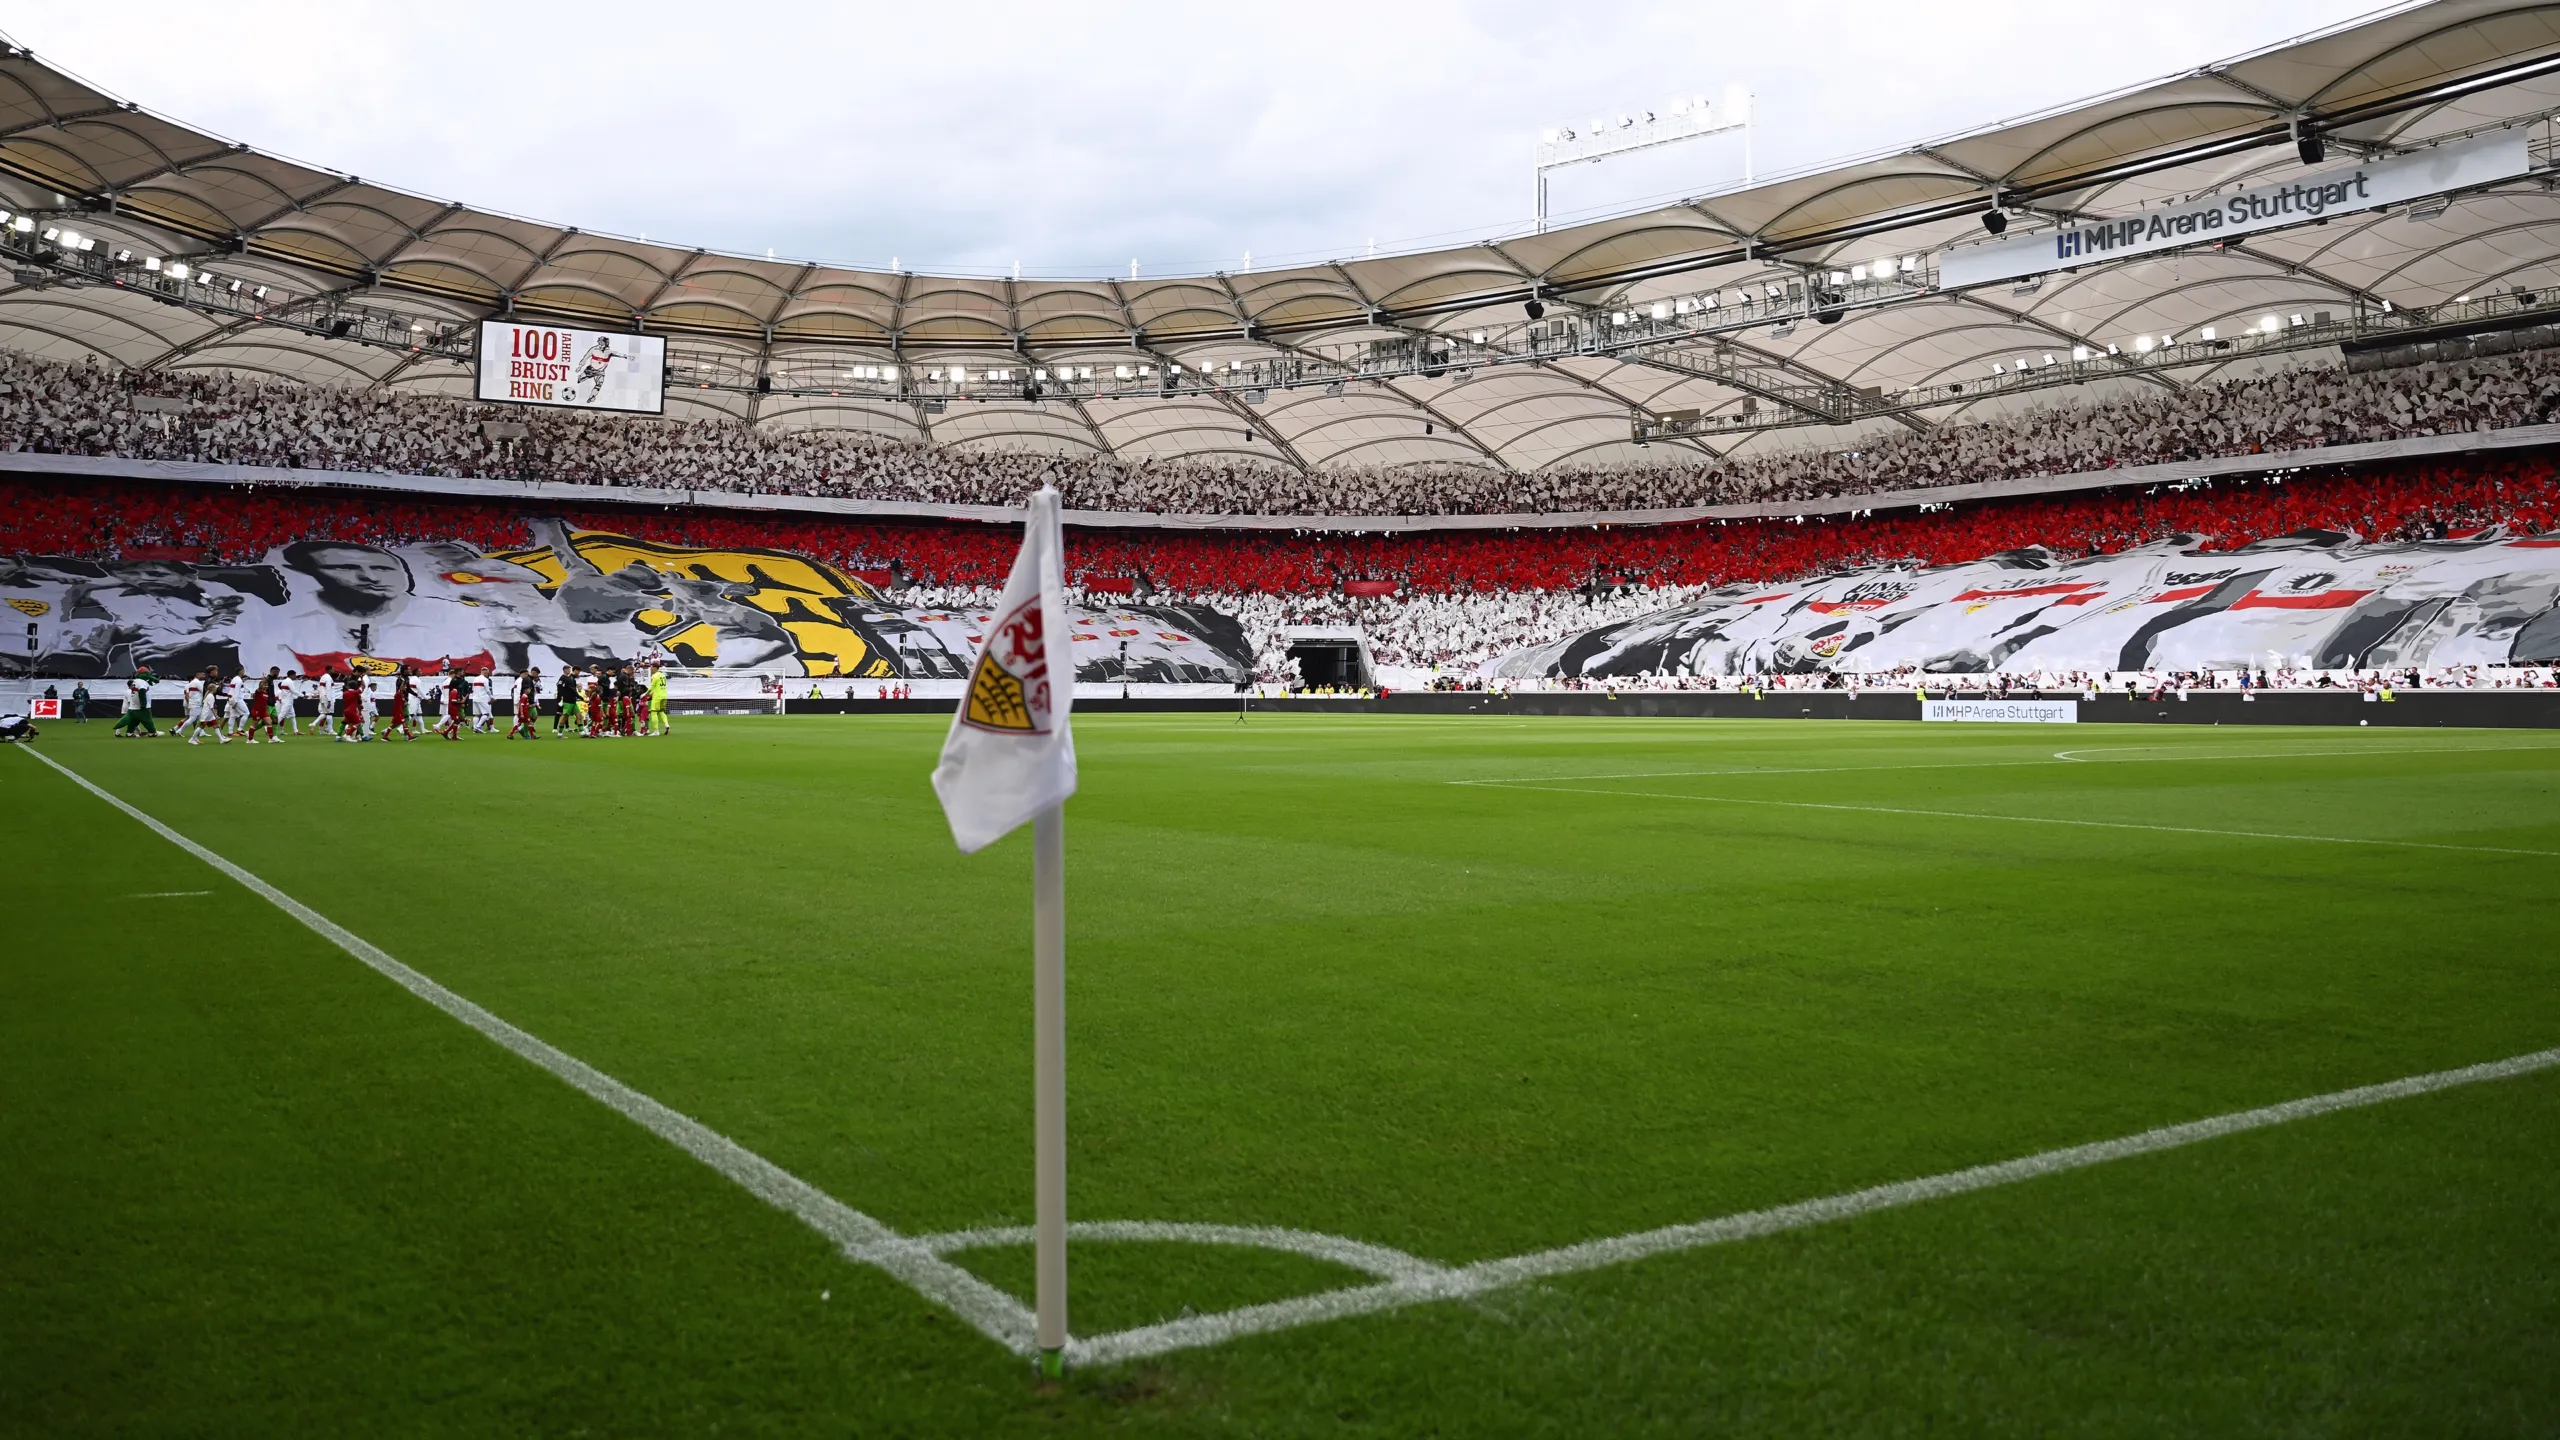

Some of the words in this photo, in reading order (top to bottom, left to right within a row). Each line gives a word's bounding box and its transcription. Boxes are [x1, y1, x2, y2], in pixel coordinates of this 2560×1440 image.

[2228, 171, 2369, 224] Stuttgart
[511, 328, 557, 361] 100
[561, 332, 572, 363] JAHRE
[510, 360, 570, 382] BRUST
[509, 380, 553, 401] RING
[2007, 705, 2064, 722] Stuttgart
